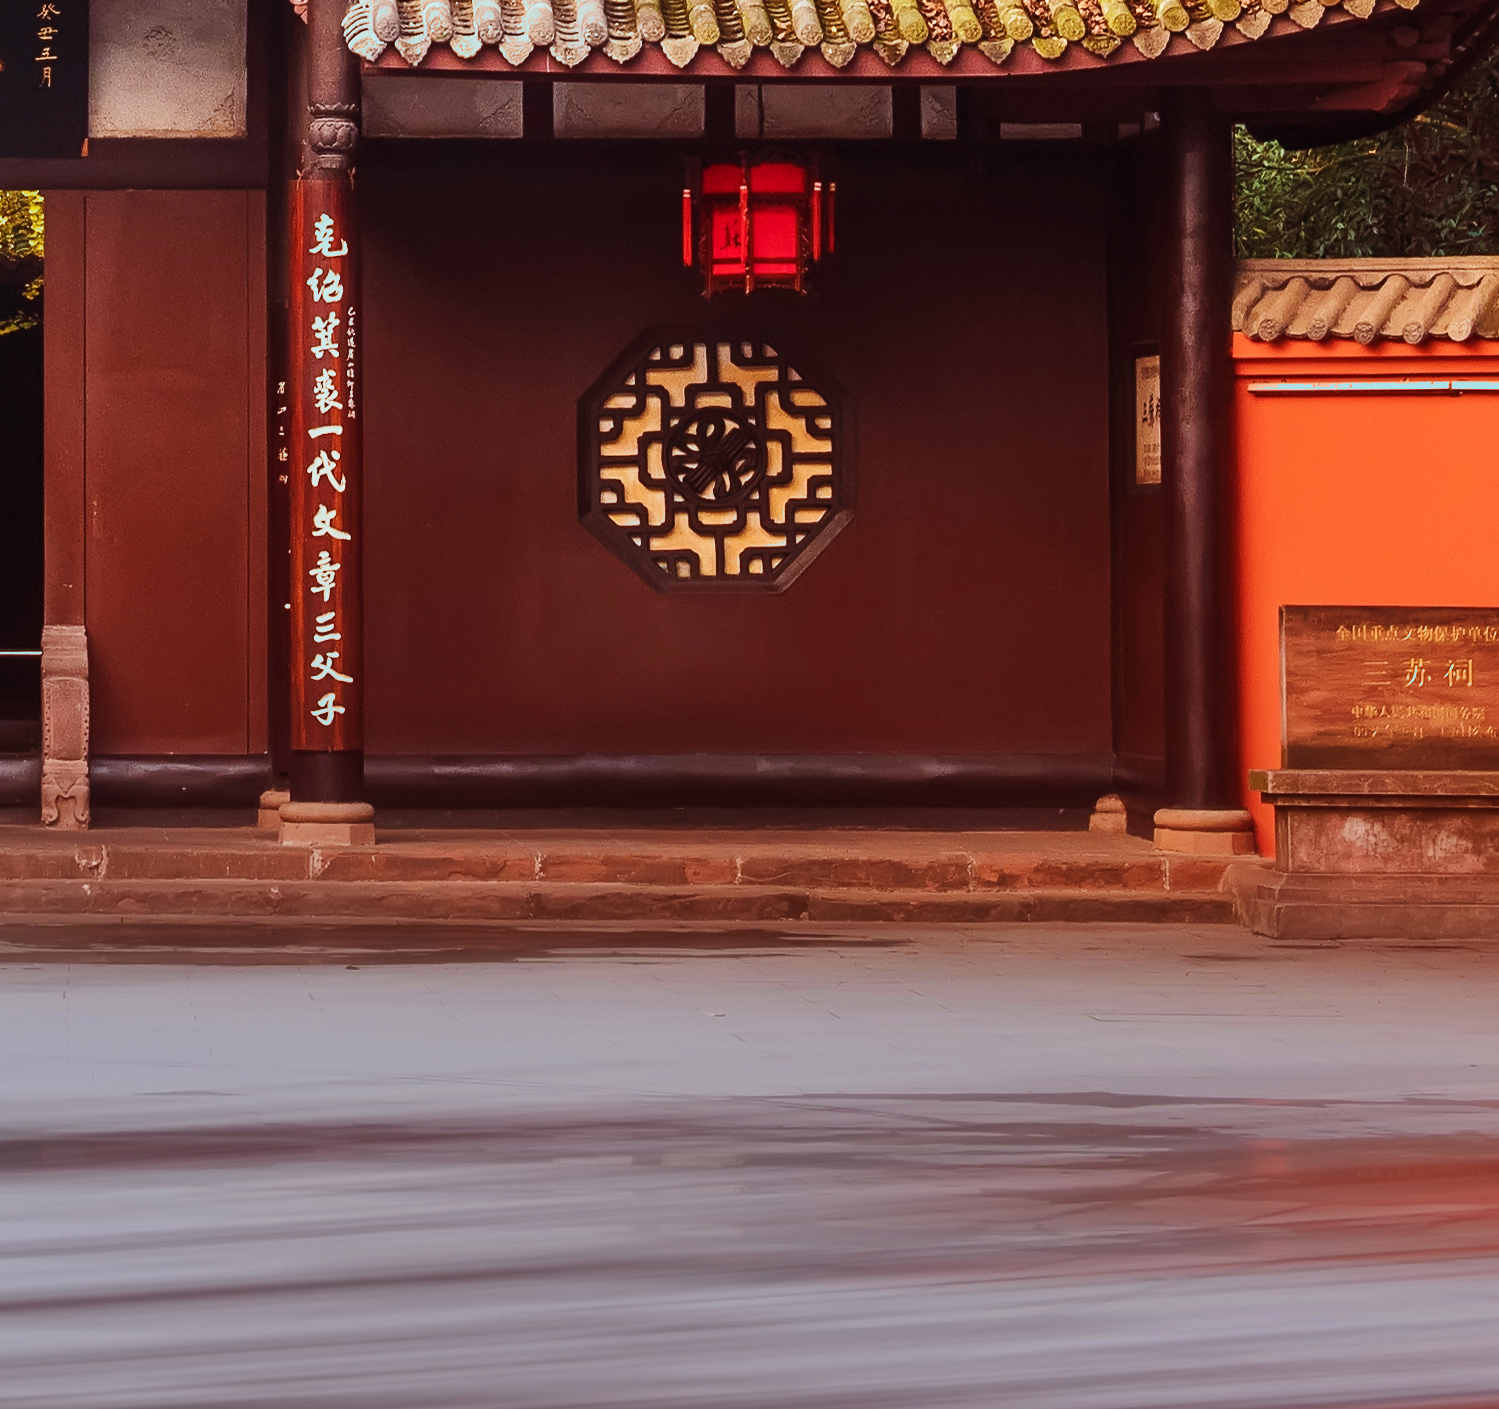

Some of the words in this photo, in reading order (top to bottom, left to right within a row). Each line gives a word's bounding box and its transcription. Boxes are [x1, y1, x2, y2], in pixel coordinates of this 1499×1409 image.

[1335, 624, 1499, 642] 全国重点文物保护单位
[1360, 657, 1474, 688] 三苏祠
